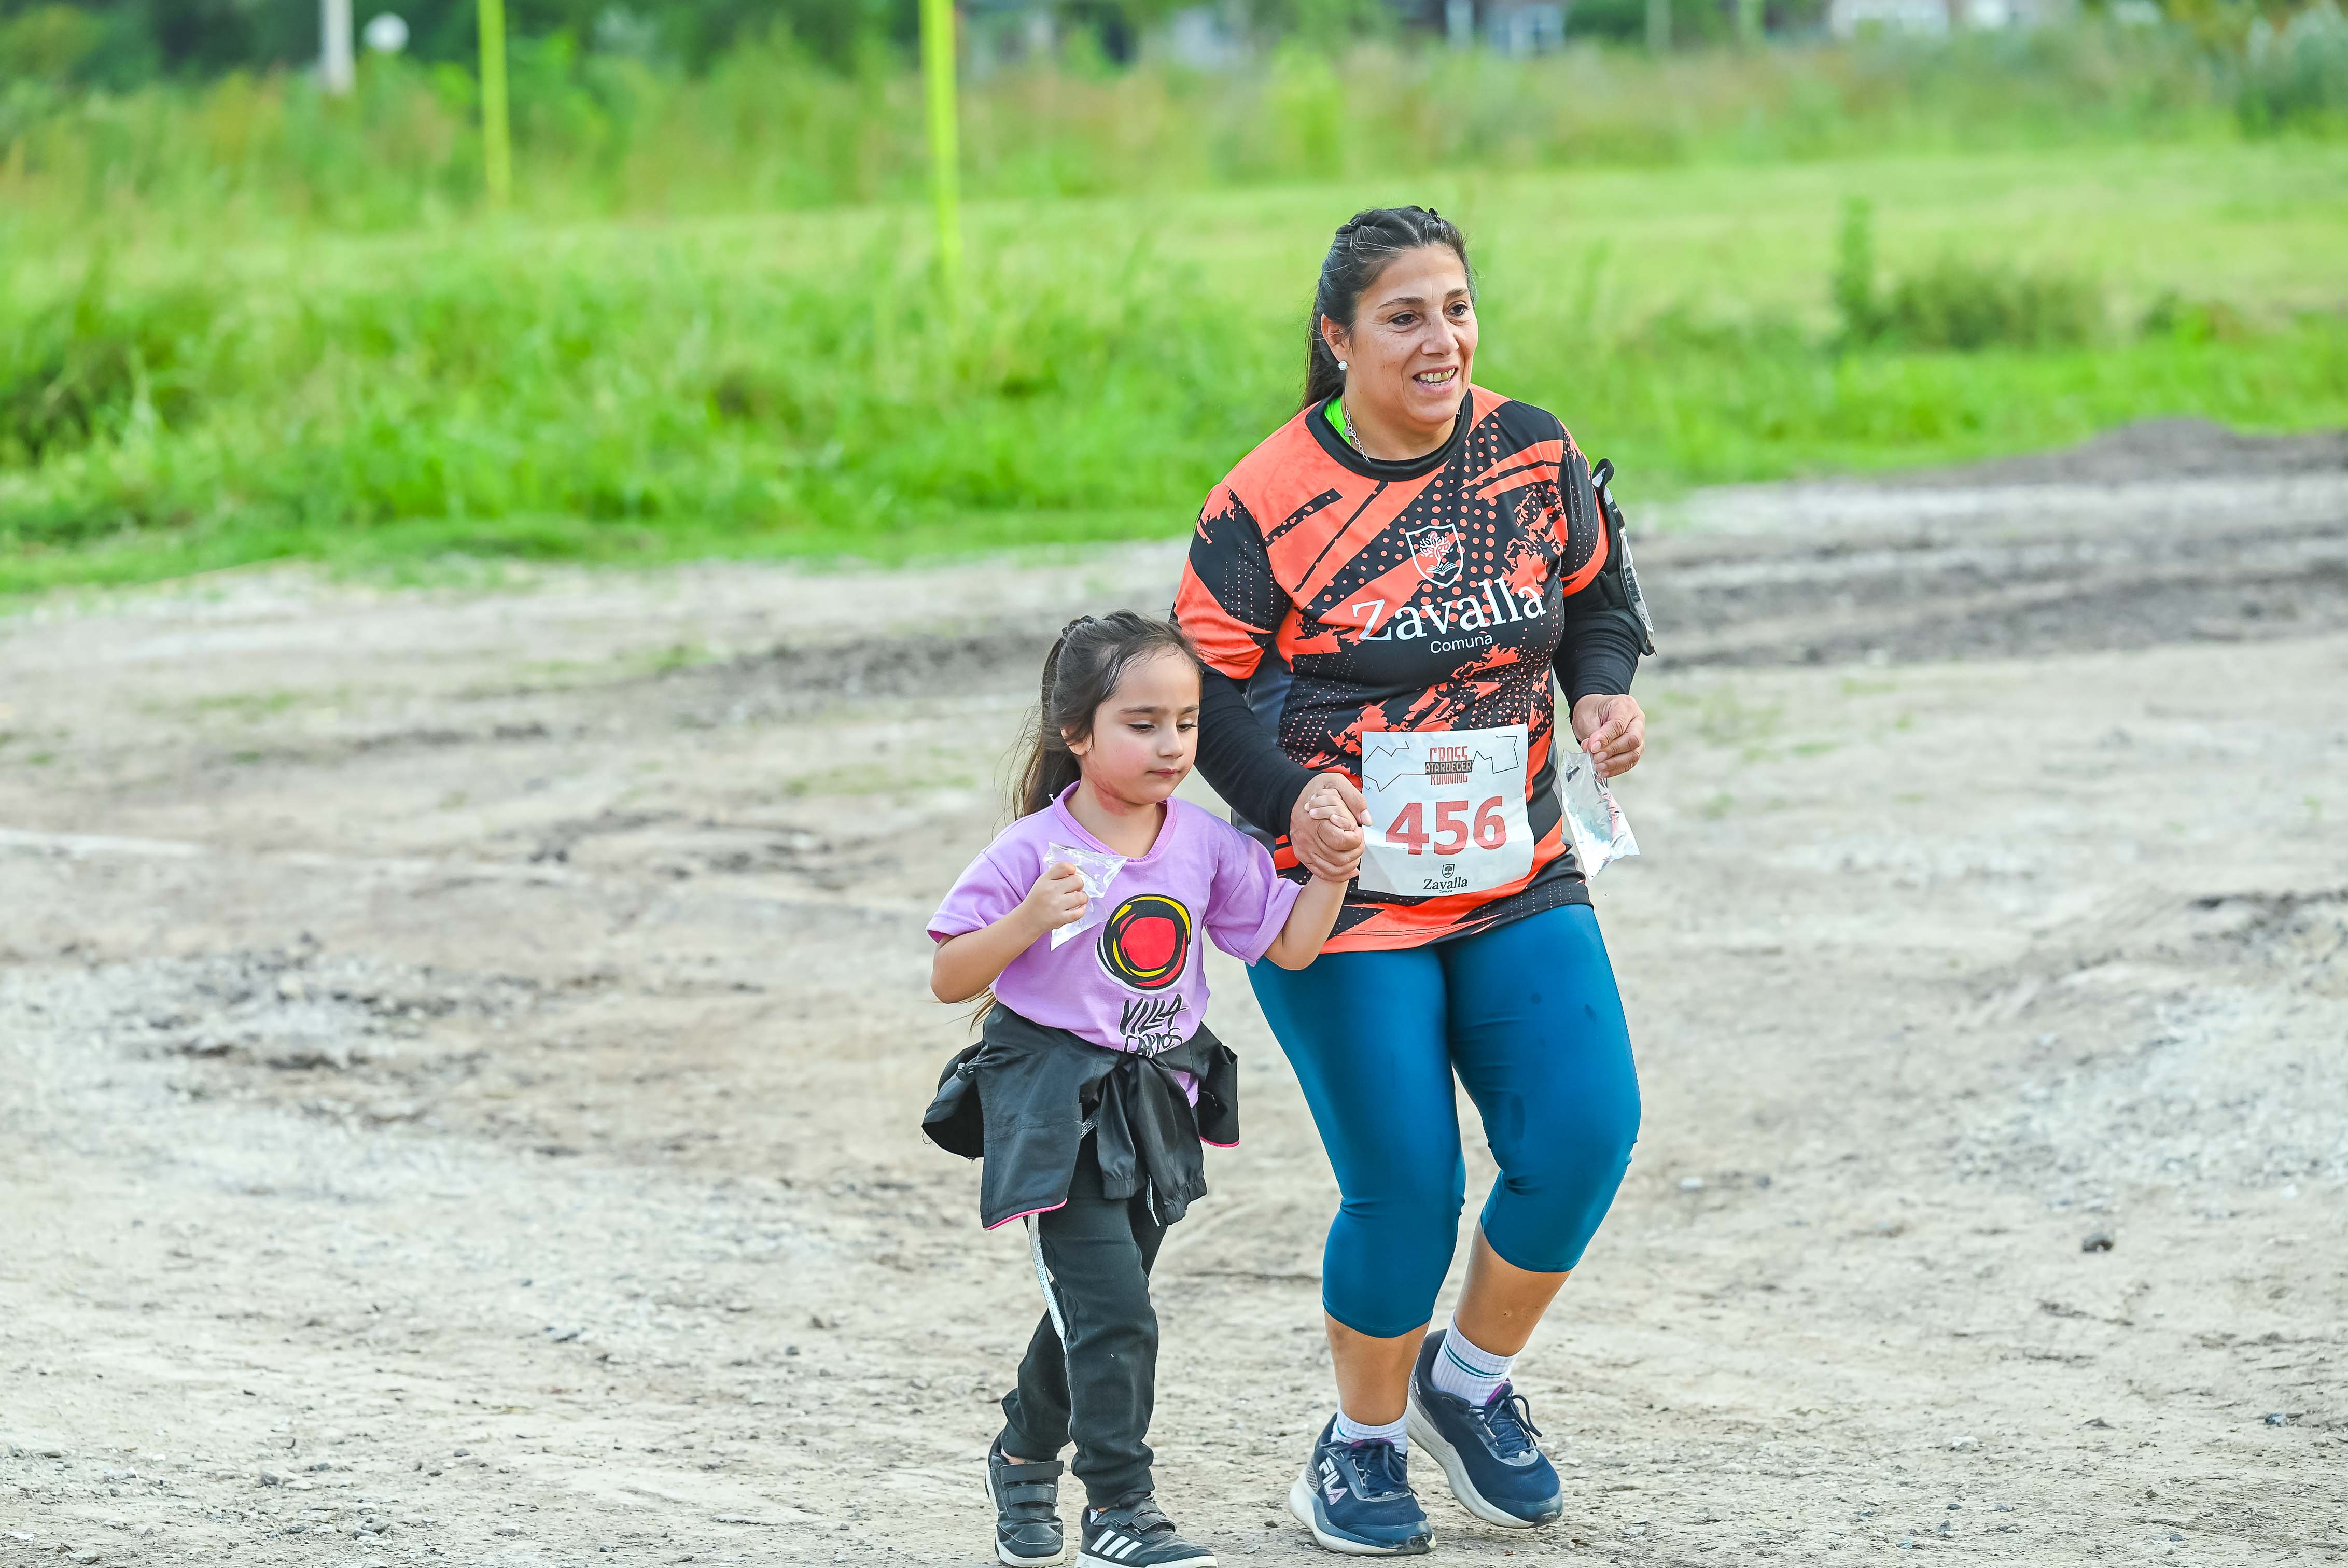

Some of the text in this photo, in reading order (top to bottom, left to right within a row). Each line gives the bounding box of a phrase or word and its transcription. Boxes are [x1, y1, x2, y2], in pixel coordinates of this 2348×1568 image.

[1352, 576, 1547, 641] Zavalla
[1430, 634, 1493, 654] Comuna
[1425, 761, 1472, 773] ATARDECER
[1429, 746, 1469, 762] CROSS
[1386, 796, 1507, 855] 456
[1423, 876, 1468, 890] Zavalla
[1119, 993, 1187, 1036] VILLA
[1318, 1457, 1348, 1506] FILA
